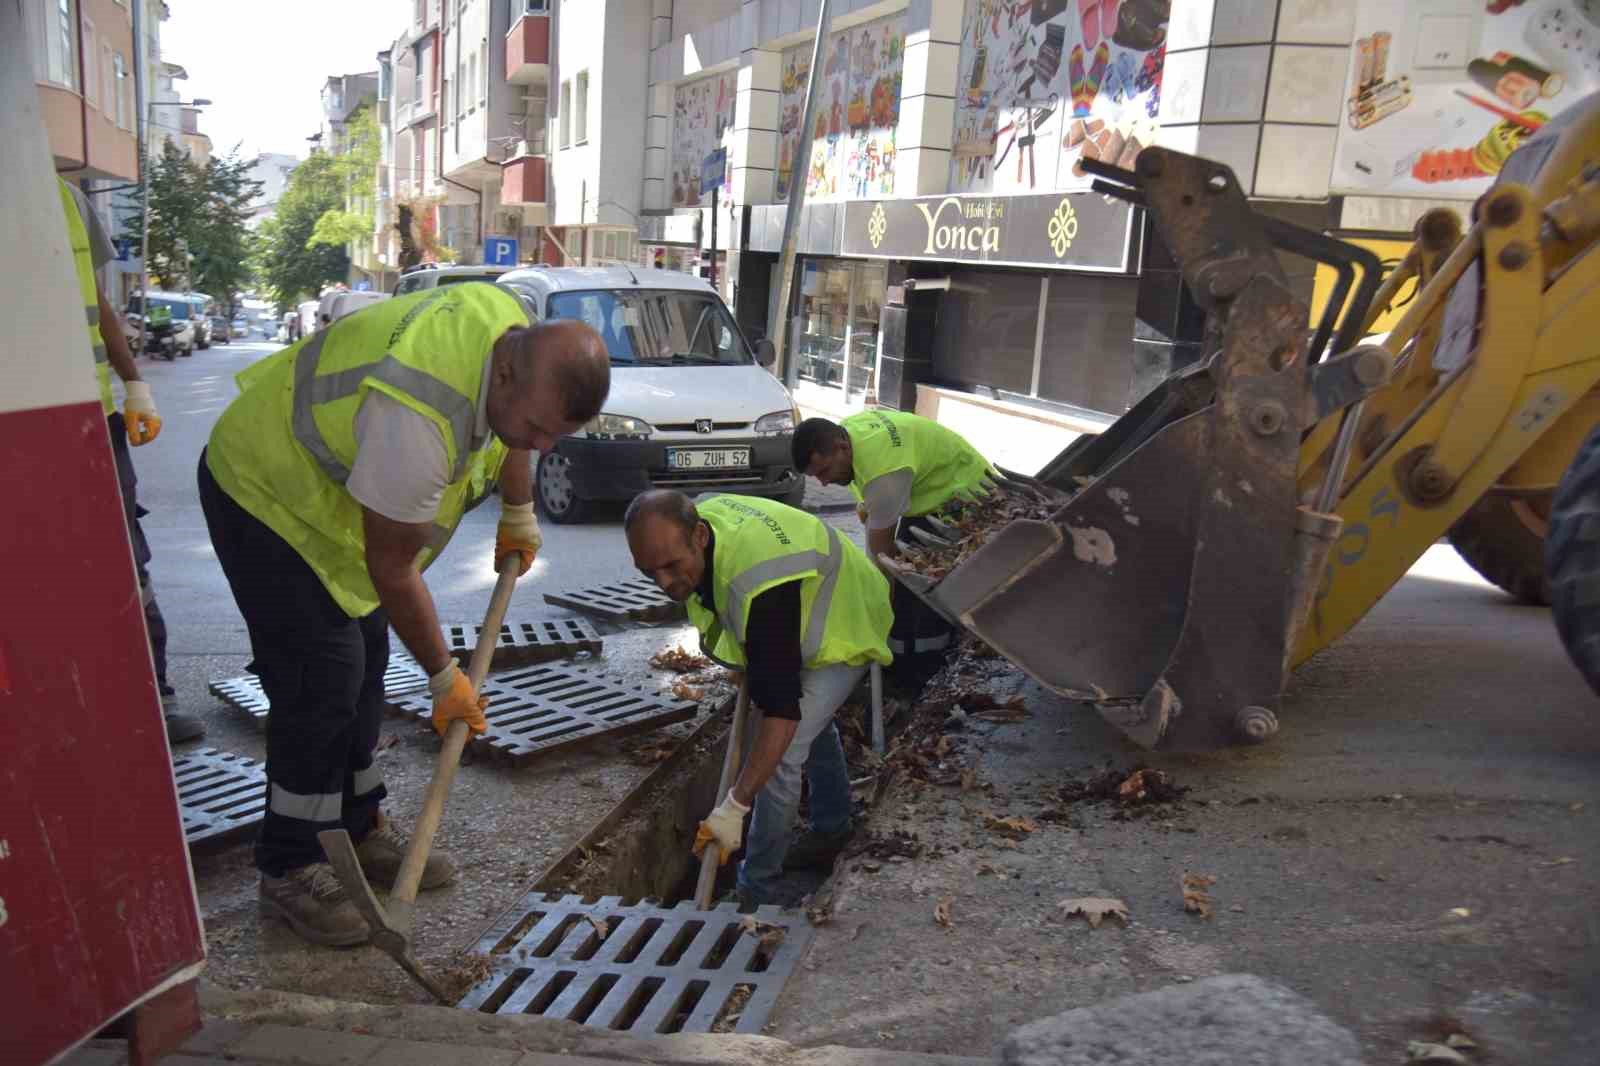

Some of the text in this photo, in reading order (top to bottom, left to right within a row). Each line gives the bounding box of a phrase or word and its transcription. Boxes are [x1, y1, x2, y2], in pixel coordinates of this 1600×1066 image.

[912, 197, 1000, 255] Yonca
[496, 242, 511, 264] P
[677, 451, 747, 466] 06 ZUH 52
